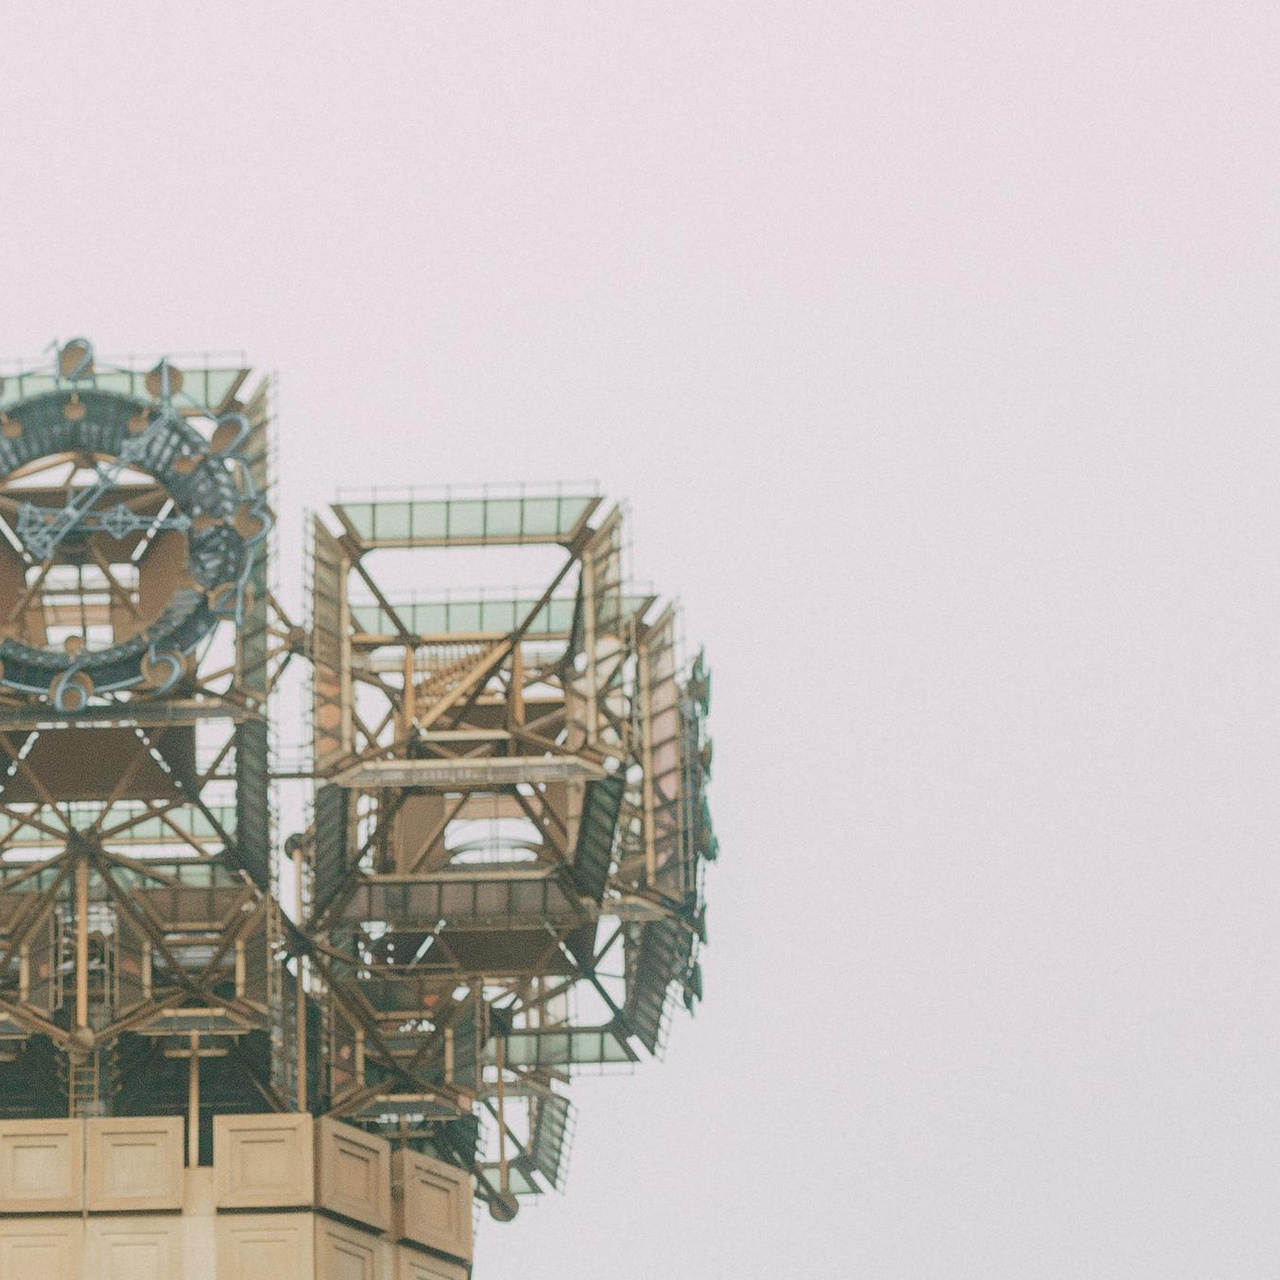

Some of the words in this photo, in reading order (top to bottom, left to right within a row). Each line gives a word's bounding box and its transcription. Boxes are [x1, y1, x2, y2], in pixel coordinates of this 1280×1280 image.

[212, 412, 251, 460] 2
[237, 495, 271, 546] 3
[54, 661, 89, 713] 6
